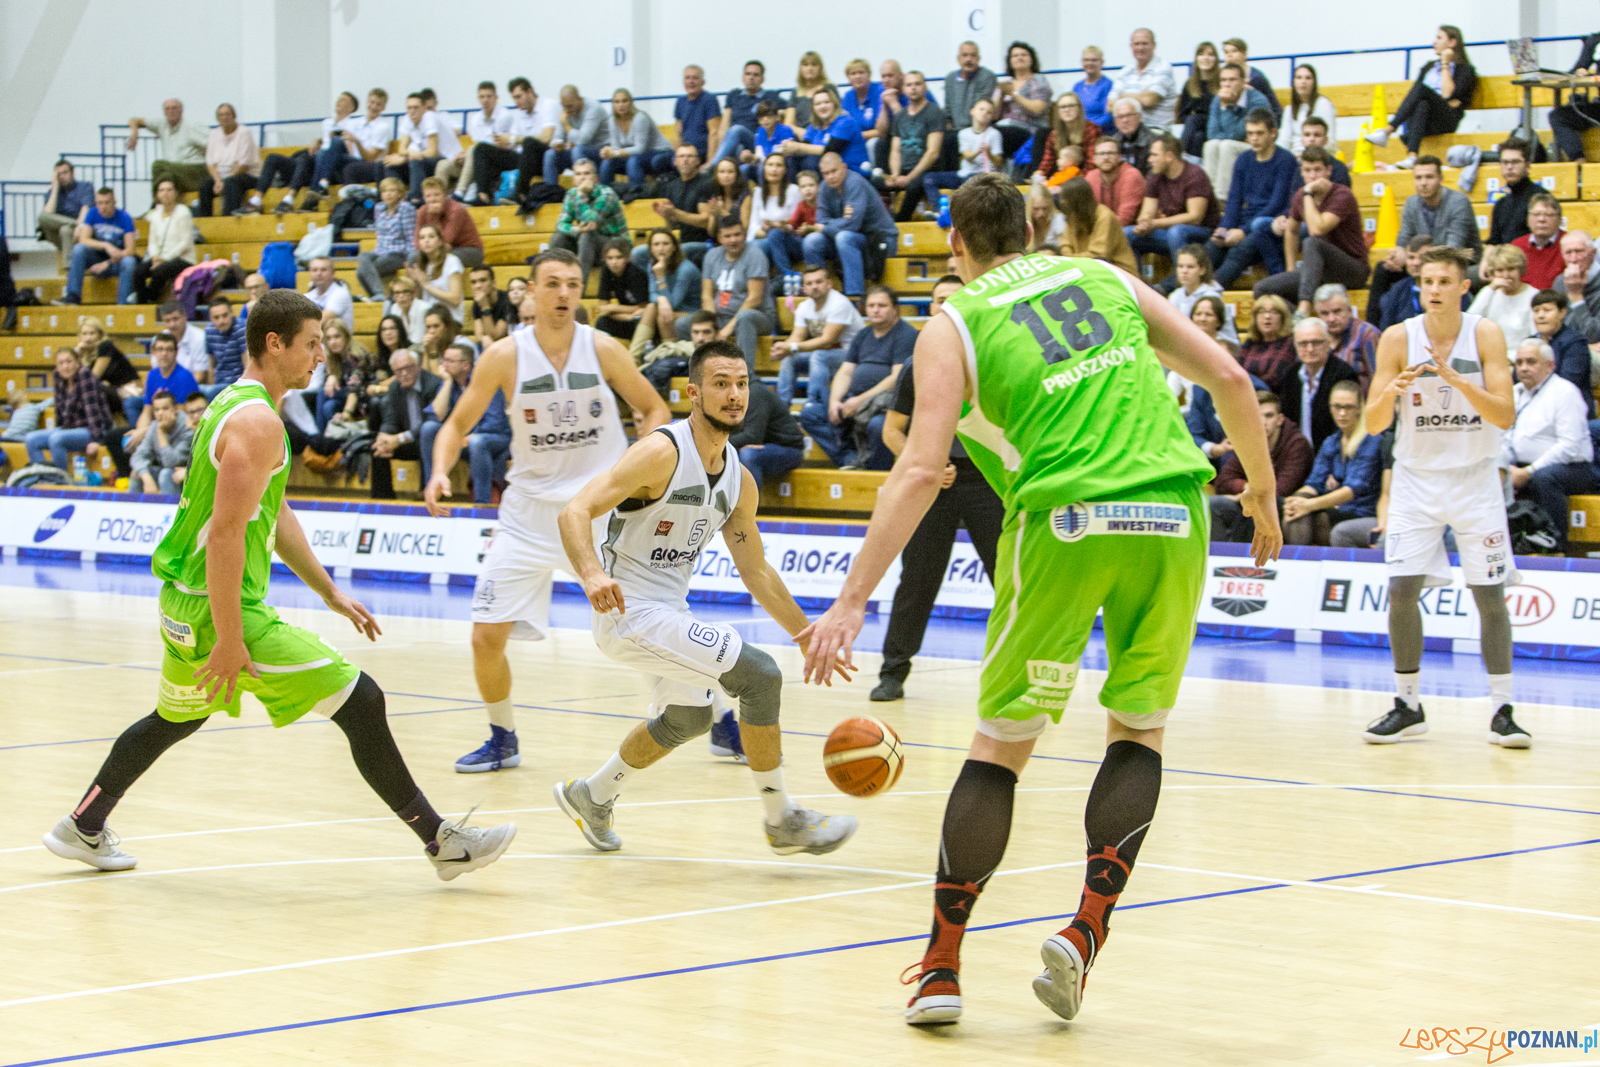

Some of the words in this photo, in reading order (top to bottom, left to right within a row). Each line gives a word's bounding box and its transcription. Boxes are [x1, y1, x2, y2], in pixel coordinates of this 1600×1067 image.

[967, 9, 984, 31] C
[613, 47, 626, 67] D
[1010, 285, 1113, 365] 18
[1041, 346, 1136, 395] PRUSZKÓW
[1437, 386, 1452, 409] 7
[546, 400, 579, 427] 14
[1415, 414, 1482, 427] BIOFARM
[530, 427, 599, 446] BIOFARM
[672, 493, 702, 503] macron
[312, 529, 350, 548] DELIK
[379, 532, 445, 556] NICKEL
[687, 519, 707, 546] 6
[1218, 581, 1265, 597] JOKER
[688, 622, 719, 647] 6
[716, 632, 731, 663] macron
